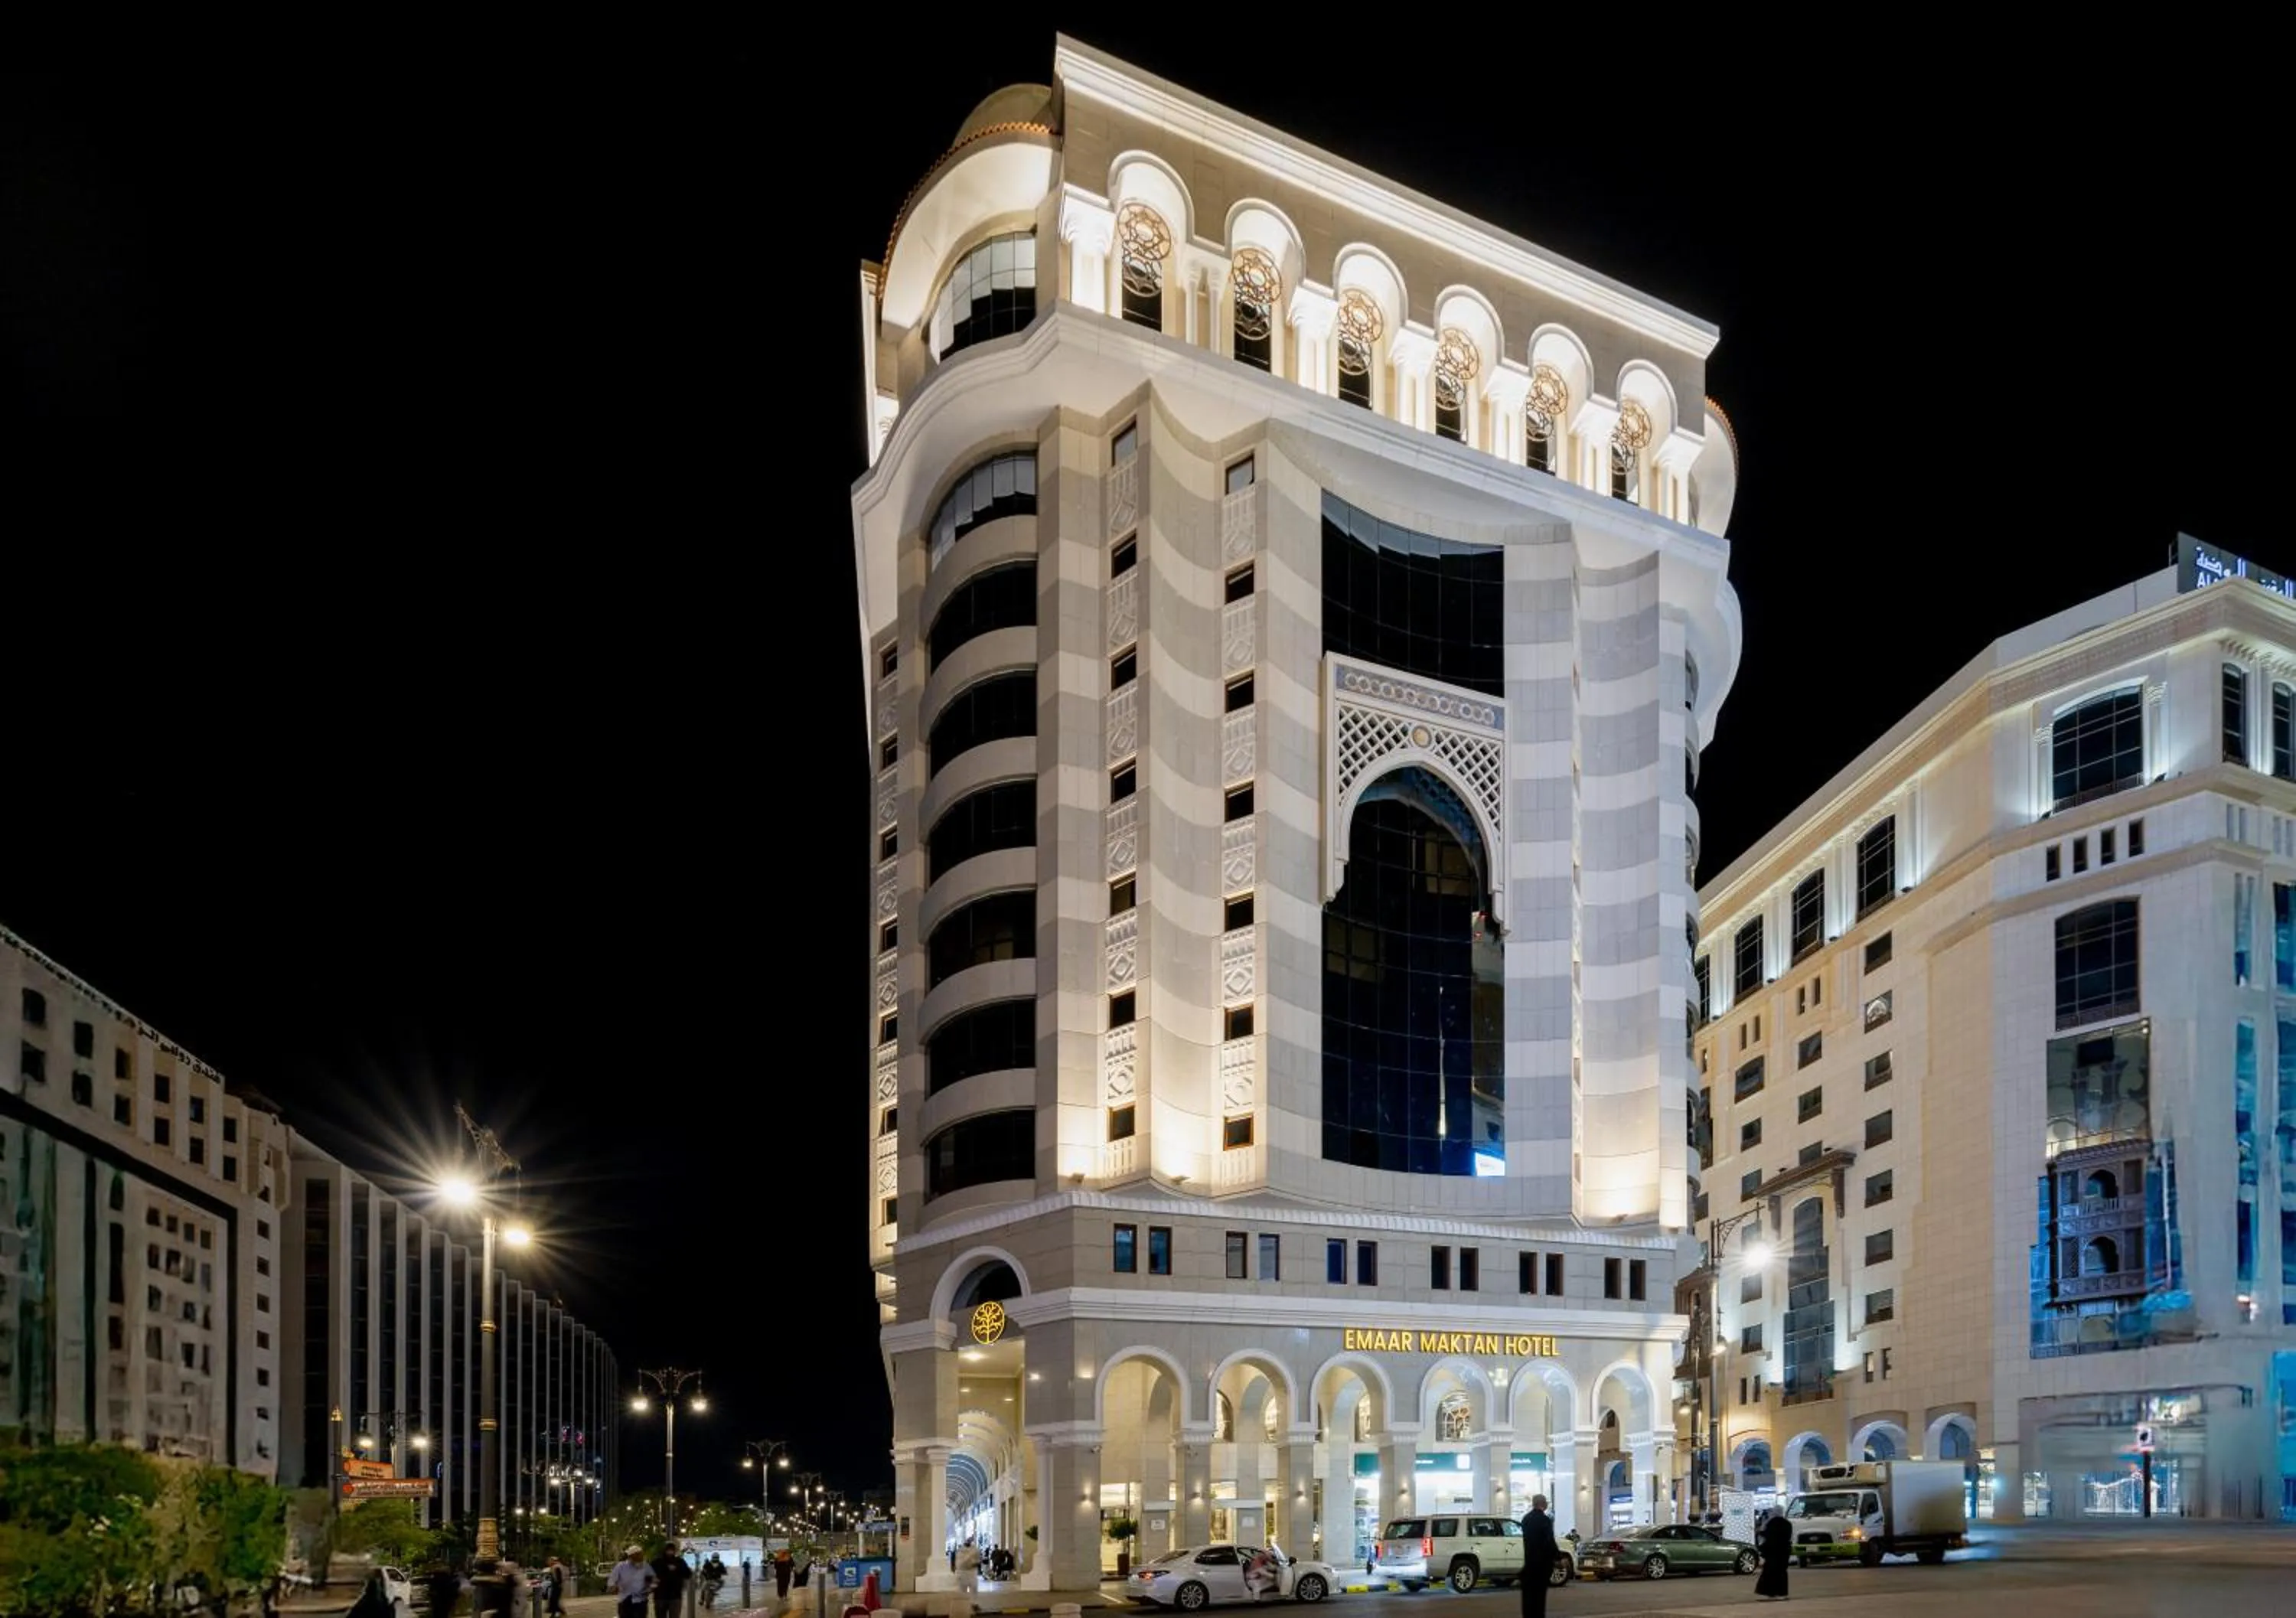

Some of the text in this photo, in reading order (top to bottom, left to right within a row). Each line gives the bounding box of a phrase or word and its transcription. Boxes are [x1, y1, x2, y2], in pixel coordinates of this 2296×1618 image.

[1345, 1329, 1561, 1356] EMAAR MAKTAN HOTEL
